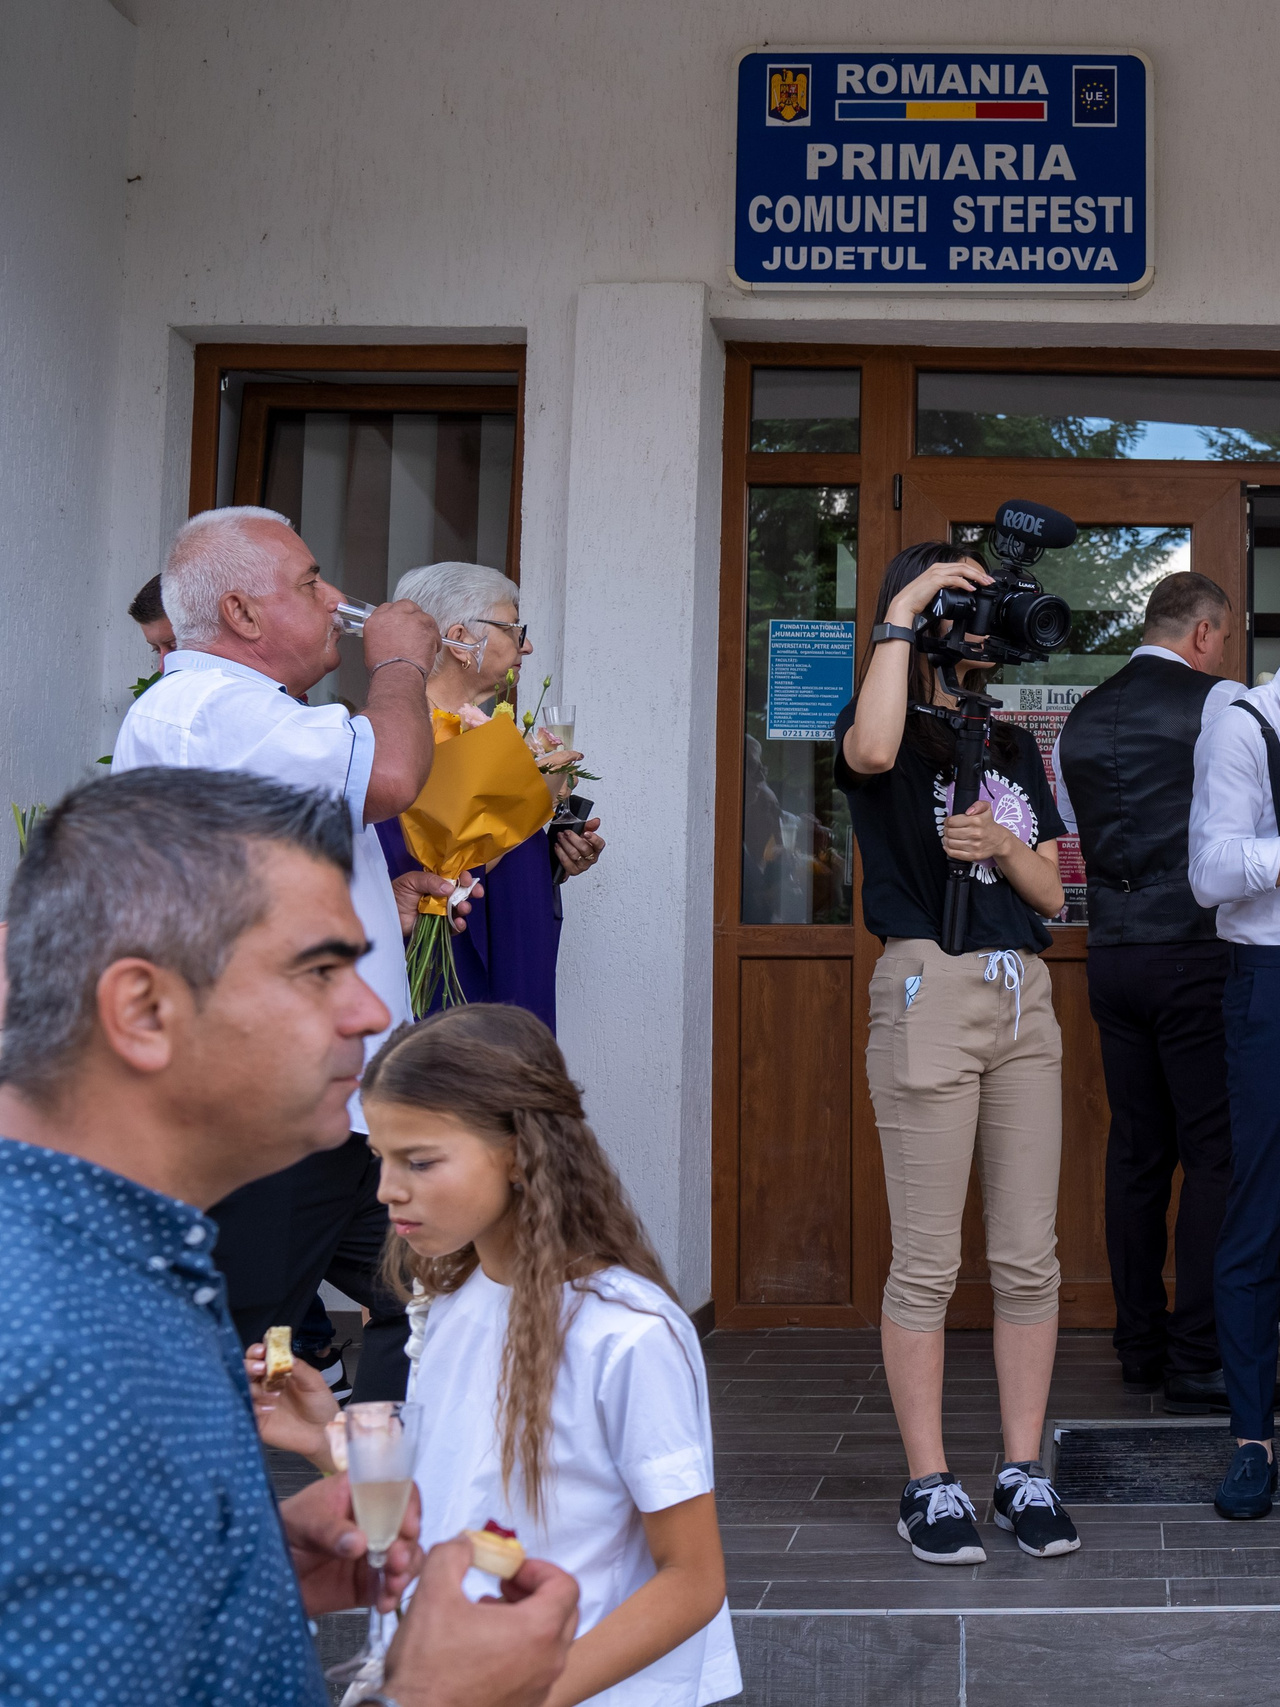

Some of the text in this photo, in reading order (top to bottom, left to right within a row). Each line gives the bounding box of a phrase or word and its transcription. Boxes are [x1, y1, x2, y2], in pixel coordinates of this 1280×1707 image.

[838, 64, 1049, 95] ROMANIA
[1085, 91, 1106, 101] U.E.
[806, 143, 1077, 181] PRIMARIA
[748, 195, 1133, 234] COMUNEI STEFESTI
[762, 246, 1118, 271] JUDETUL PRAHOVA
[1047, 688, 1092, 705] Info
